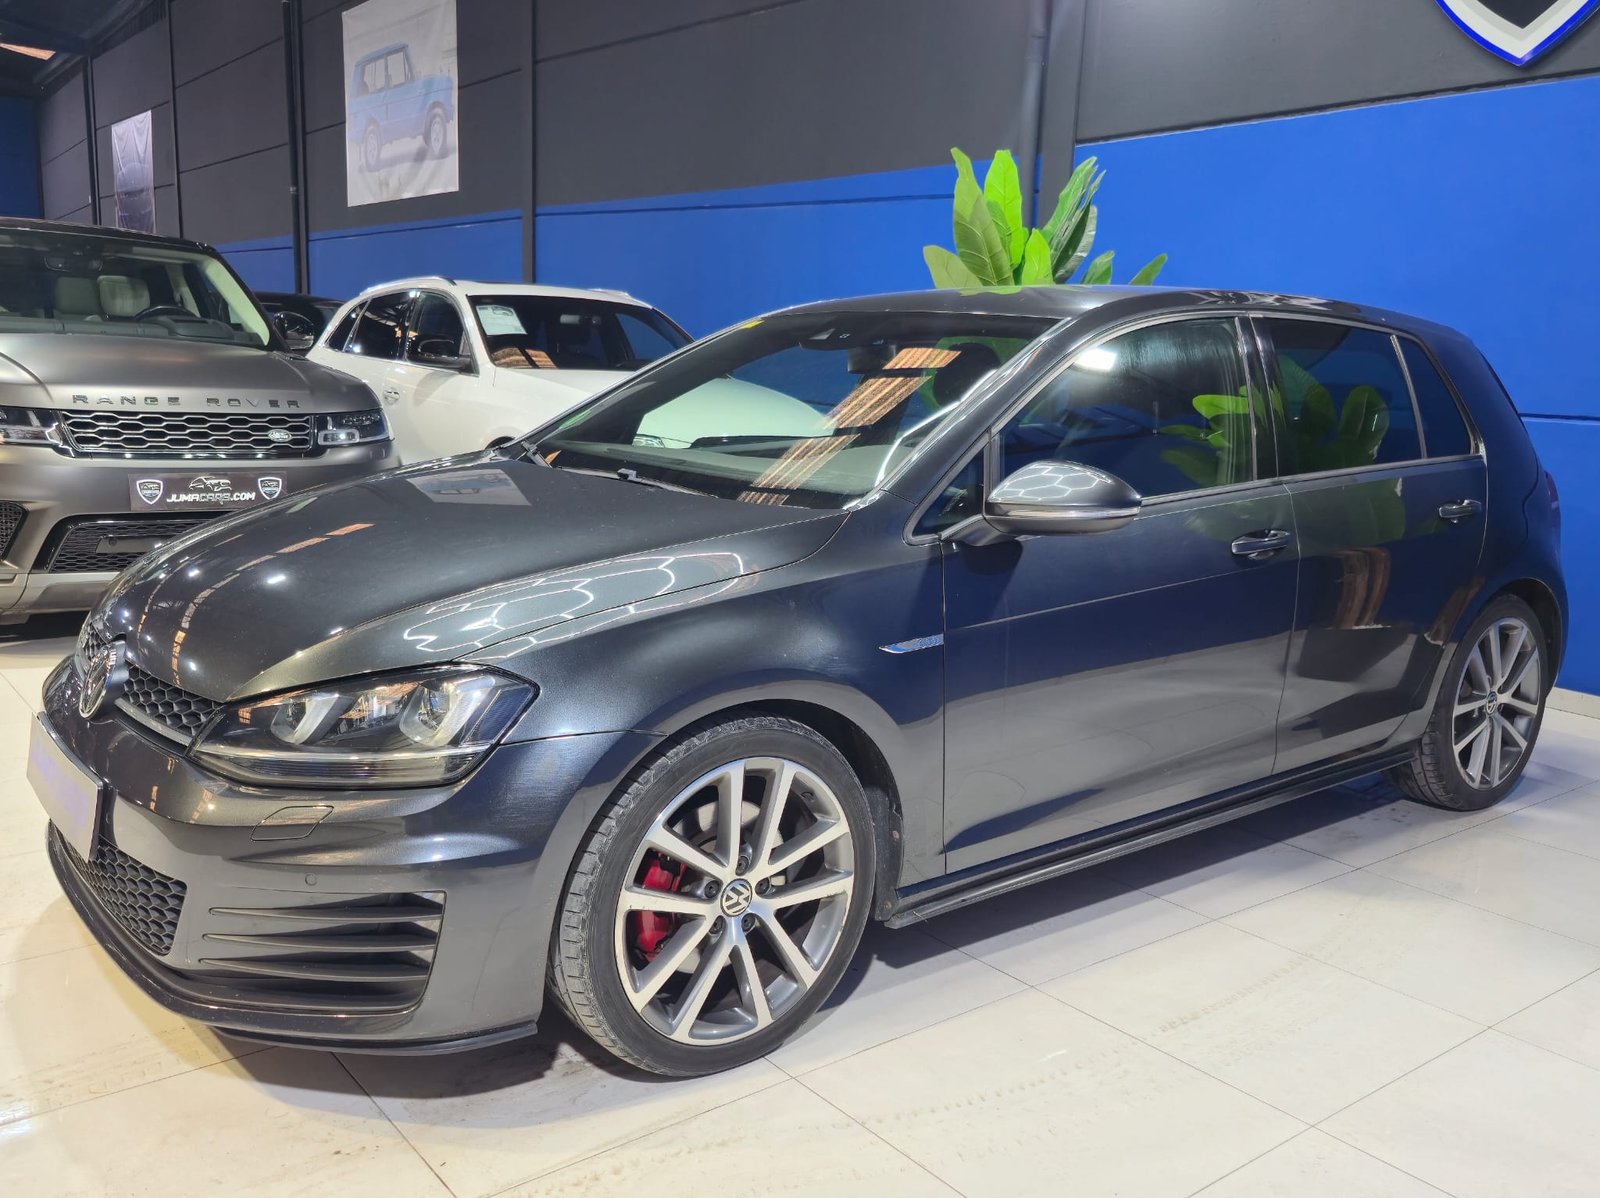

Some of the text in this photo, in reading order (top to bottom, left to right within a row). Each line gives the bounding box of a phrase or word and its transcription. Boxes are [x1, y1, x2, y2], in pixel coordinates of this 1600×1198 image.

[72, 394, 300, 409] RANGE ROVER
[166, 491, 256, 503] JUMACARS.COM
